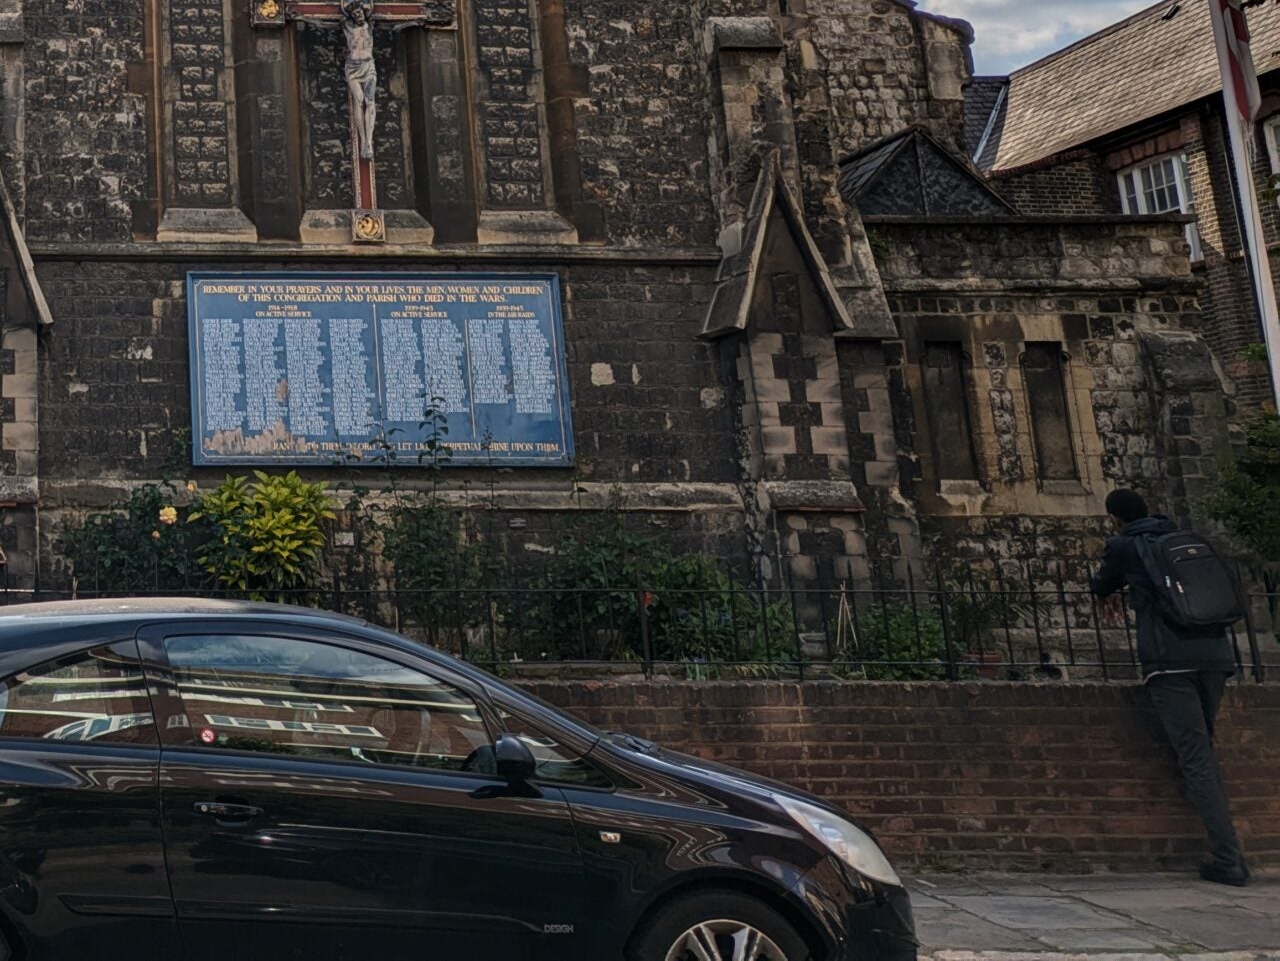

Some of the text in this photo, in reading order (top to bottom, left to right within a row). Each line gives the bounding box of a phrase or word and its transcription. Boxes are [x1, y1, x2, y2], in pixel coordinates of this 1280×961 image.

[203, 285, 245, 294] REMEMBER
[248, 285, 257, 294] IN
[260, 285, 284, 294] YOUR
[286, 285, 321, 294] PRAYERS
[325, 285, 343, 294] AND
[345, 285, 354, 294] IN
[355, 285, 379, 294] YOUR
[406, 285, 424, 294] THE
[447, 286, 480, 295] WOMEN
[482, 286, 500, 295] AND
[503, 286, 544, 295] CHILDREN
[238, 294, 250, 303] OF
[252, 294, 272, 303] THIS
[274, 294, 342, 303] CONGREGATION
[345, 294, 364, 303] AND
[366, 294, 397, 303] PARISH
[399, 294, 421, 303] WHO
[424, 294, 444, 303] DIED
[447, 294, 456, 303] IN
[458, 294, 477, 303] THE
[398, 442, 412, 451] LET
[511, 442, 533, 451] UPON
[544, 924, 574, 933] DESIGN
